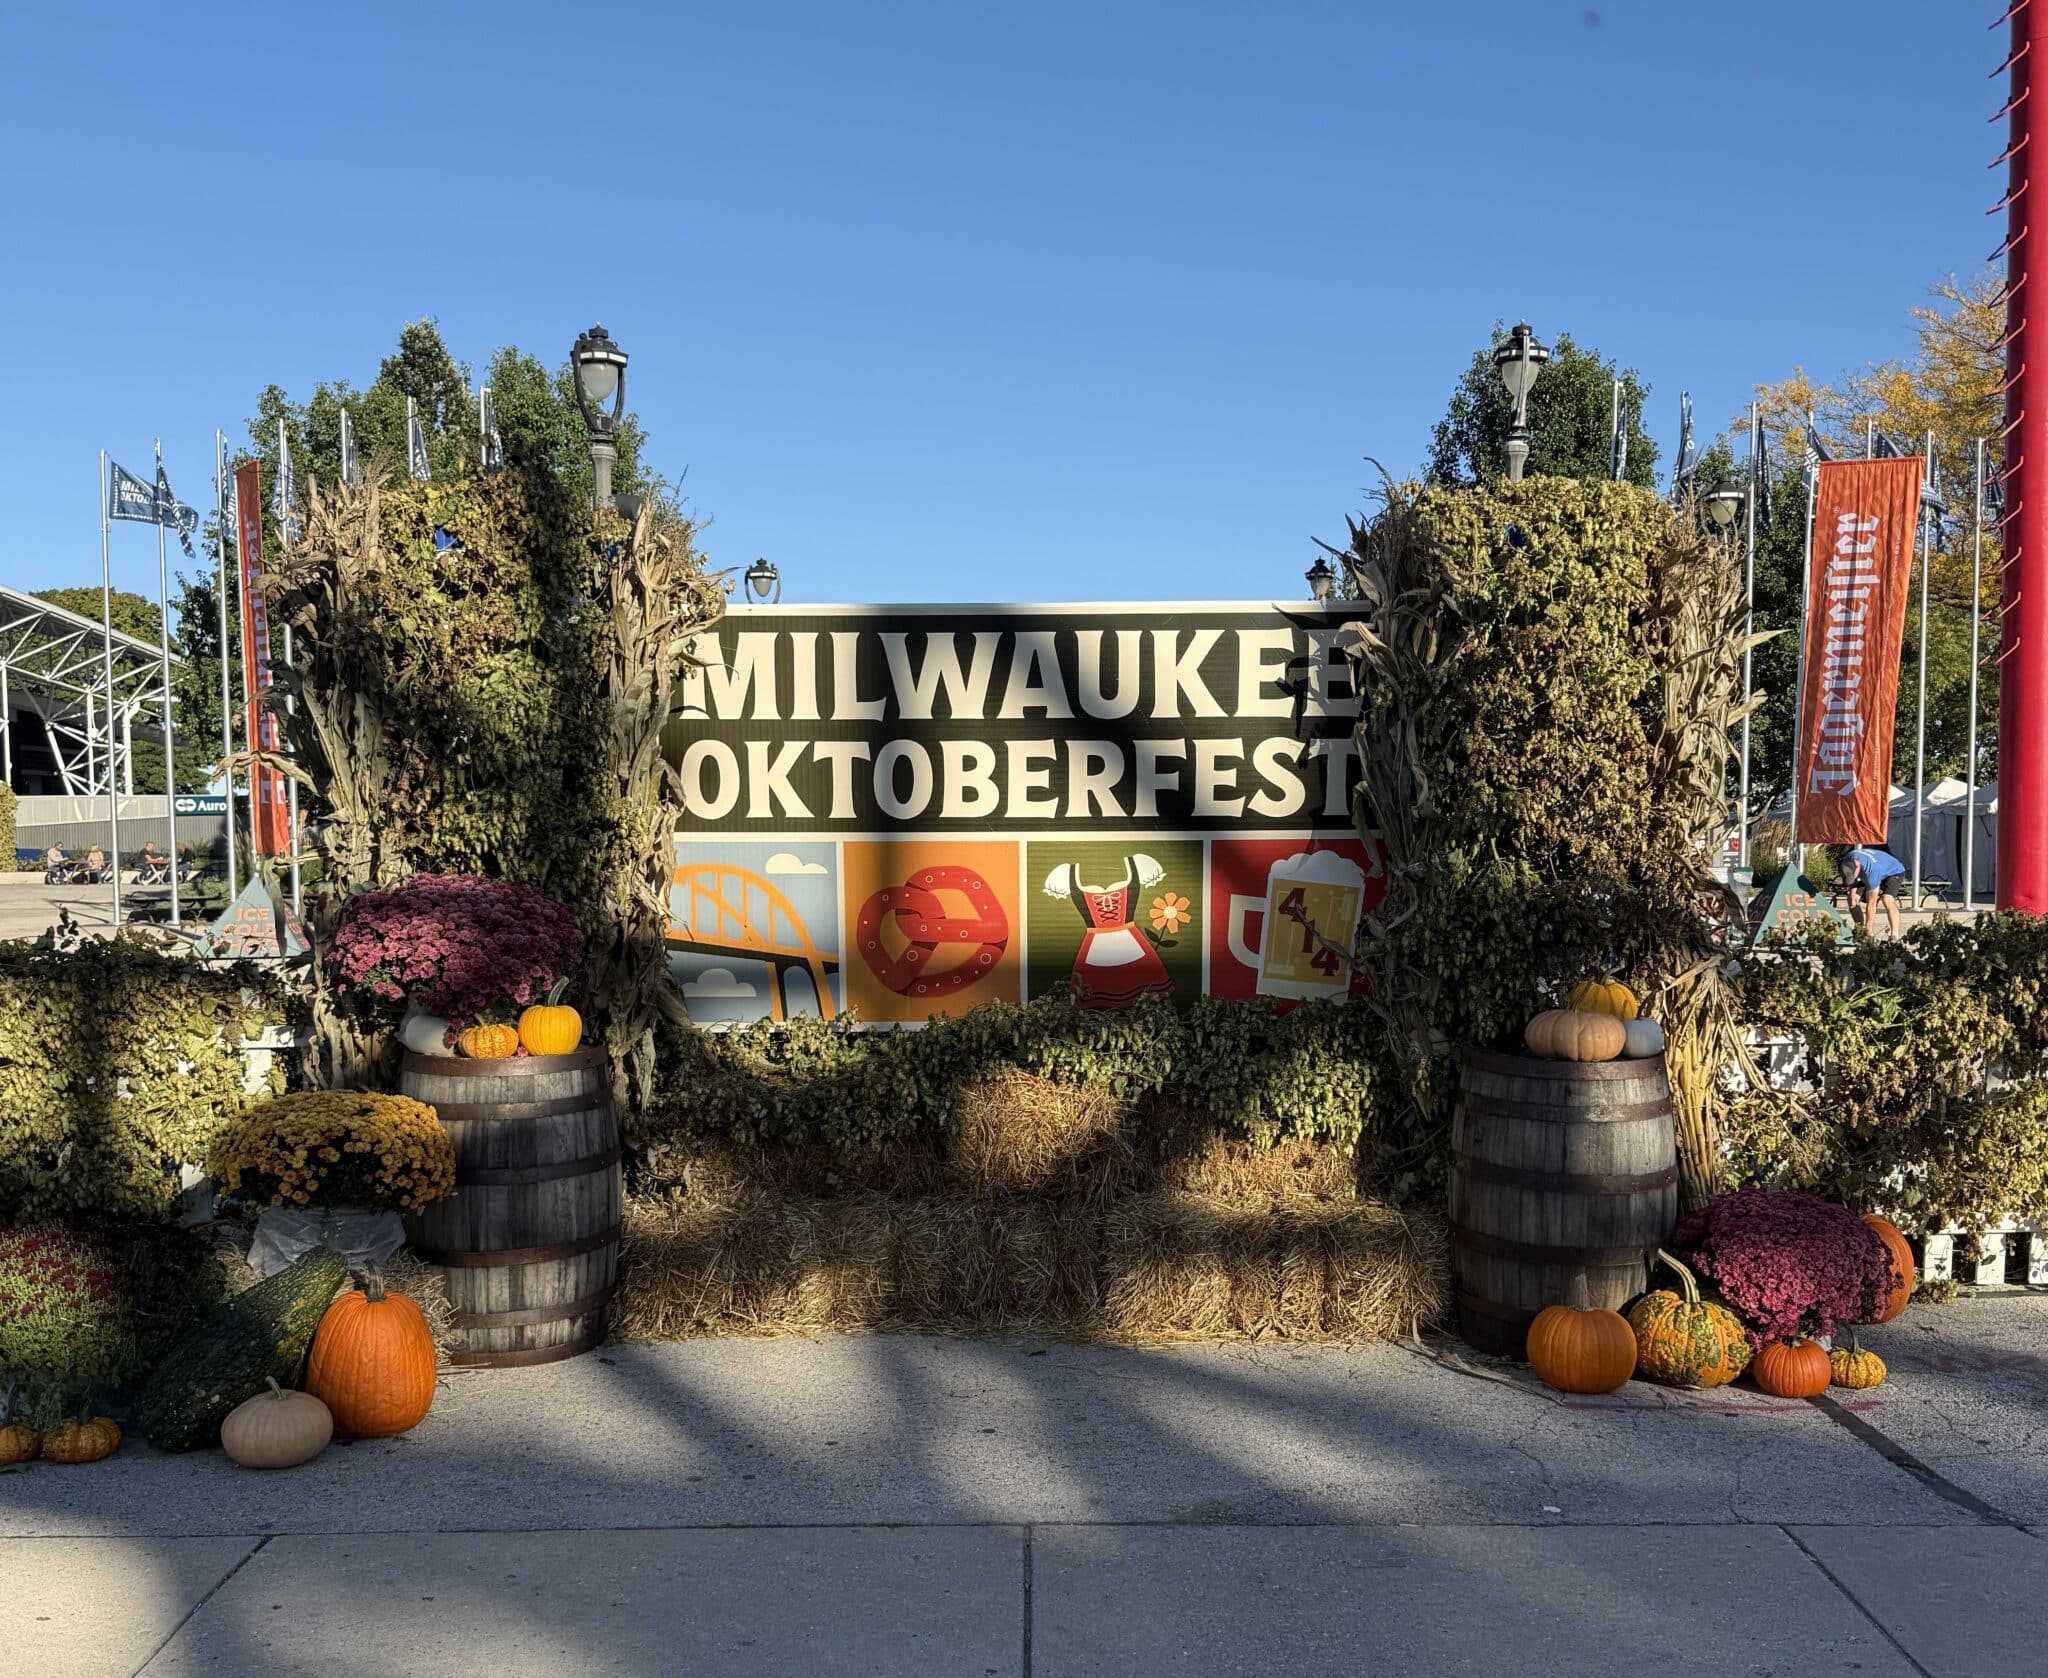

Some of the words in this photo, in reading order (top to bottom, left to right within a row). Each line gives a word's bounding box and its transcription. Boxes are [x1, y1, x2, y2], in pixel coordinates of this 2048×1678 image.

[678, 627, 1364, 721] MILWAUKEE
[679, 736, 1361, 820] OKTOBERFEST
[198, 799, 228, 812] Auro
[1784, 893, 1817, 907] ICE
[235, 907, 269, 922] ICE
